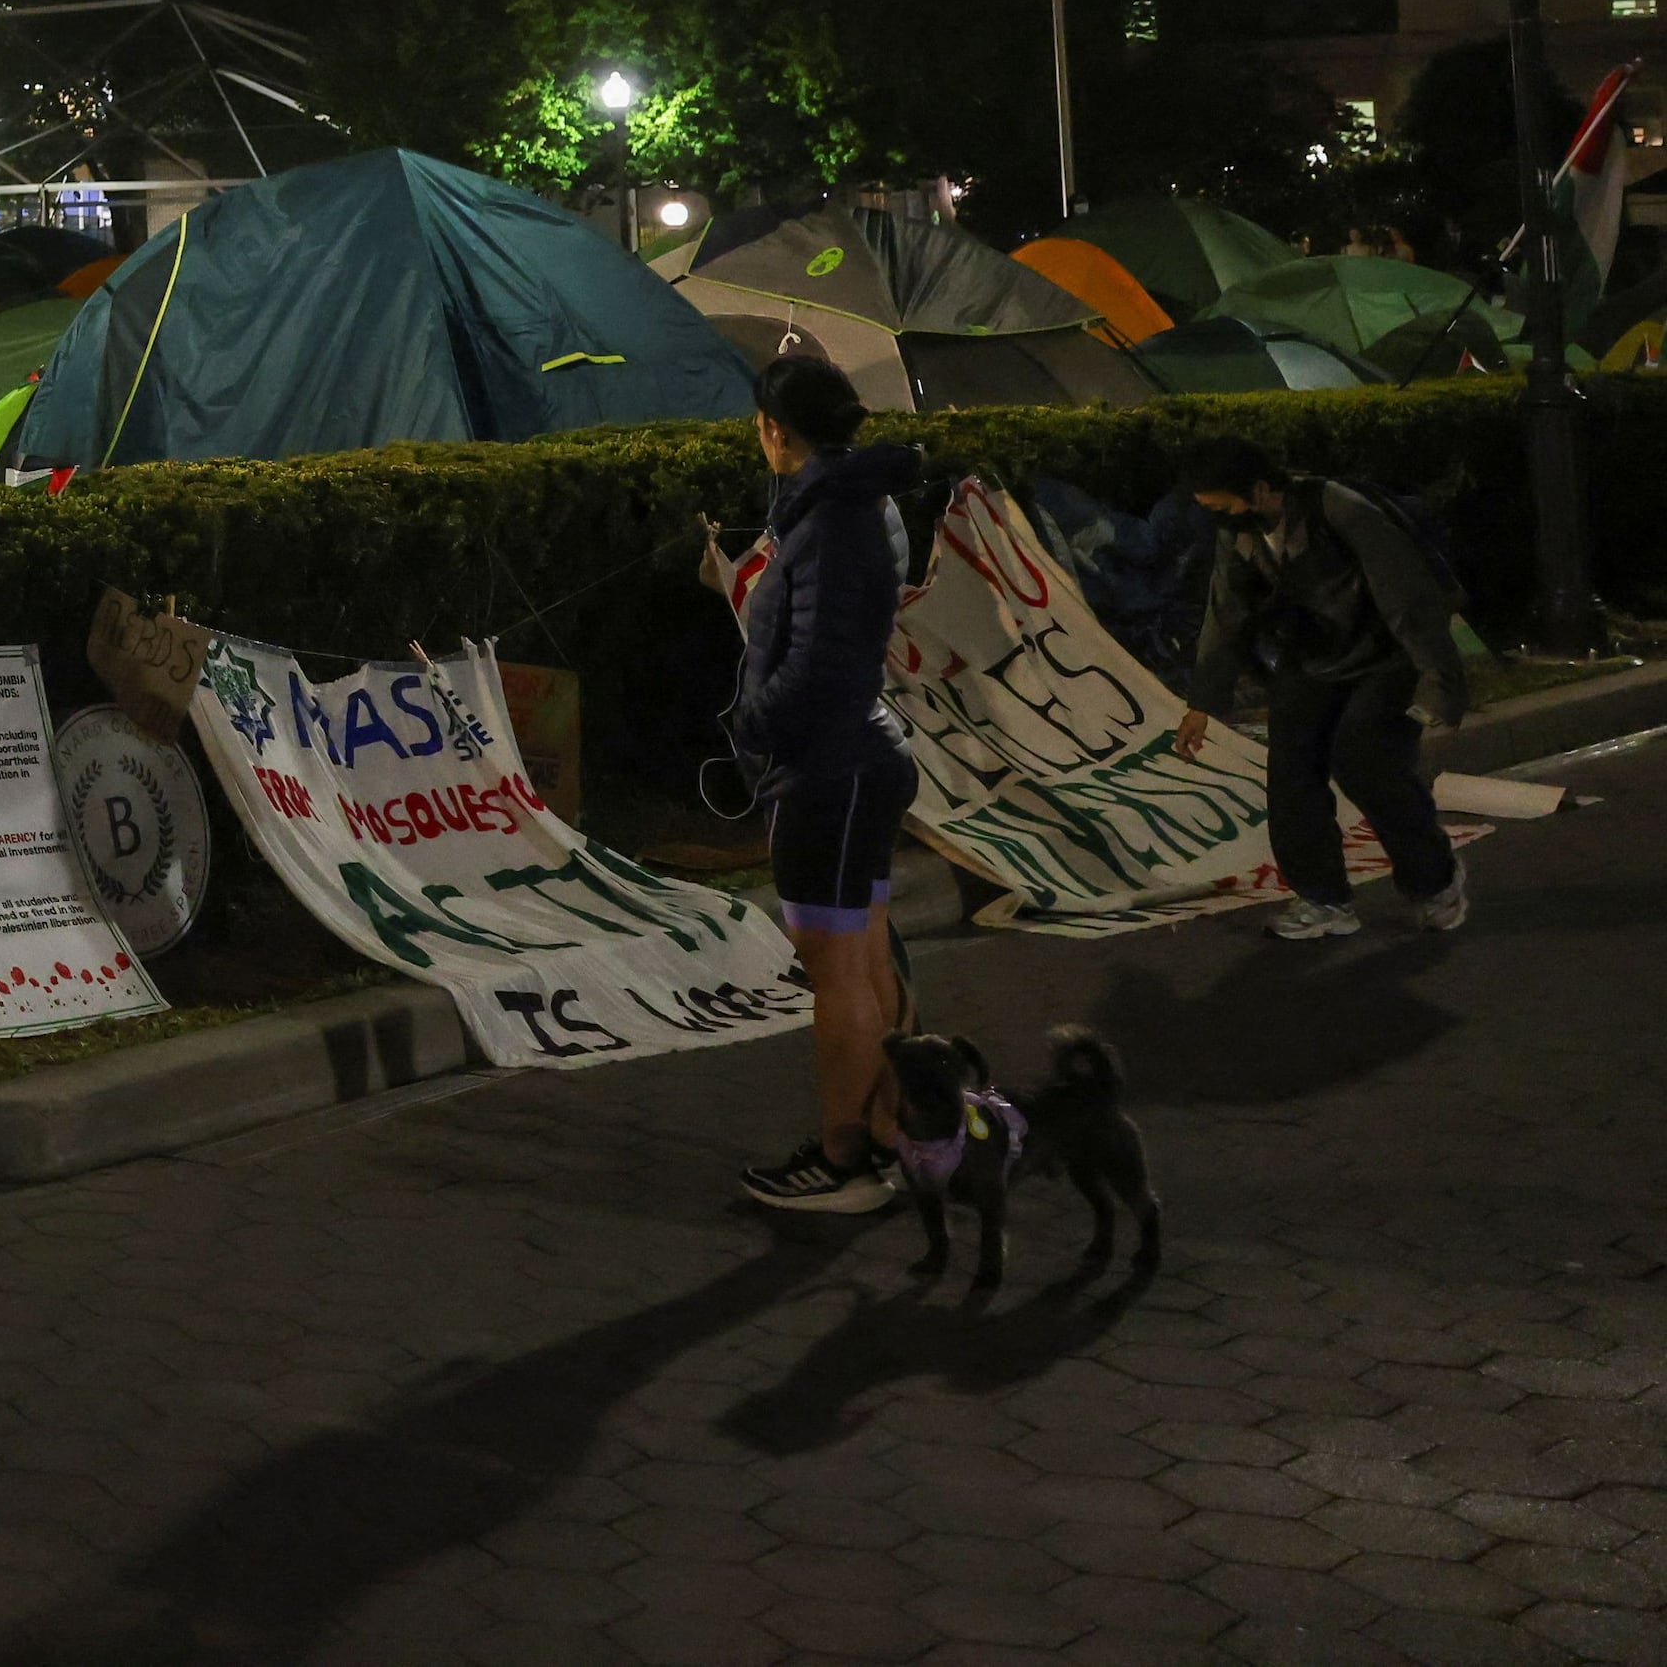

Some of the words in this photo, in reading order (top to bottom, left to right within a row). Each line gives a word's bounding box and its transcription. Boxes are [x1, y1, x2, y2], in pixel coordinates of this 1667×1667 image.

[20, 768, 30, 778] in
[339, 783, 521, 845] MOSQUES
[104, 795, 141, 859] B
[39, 831, 53, 841] for
[2, 898, 13, 909] all
[16, 896, 59, 908] students
[61, 892, 79, 903] and
[20, 910, 29, 920] or
[32, 906, 57, 917] fired
[59, 906, 69, 914] in
[70, 903, 84, 914] the
[494, 989, 632, 1058] IS
